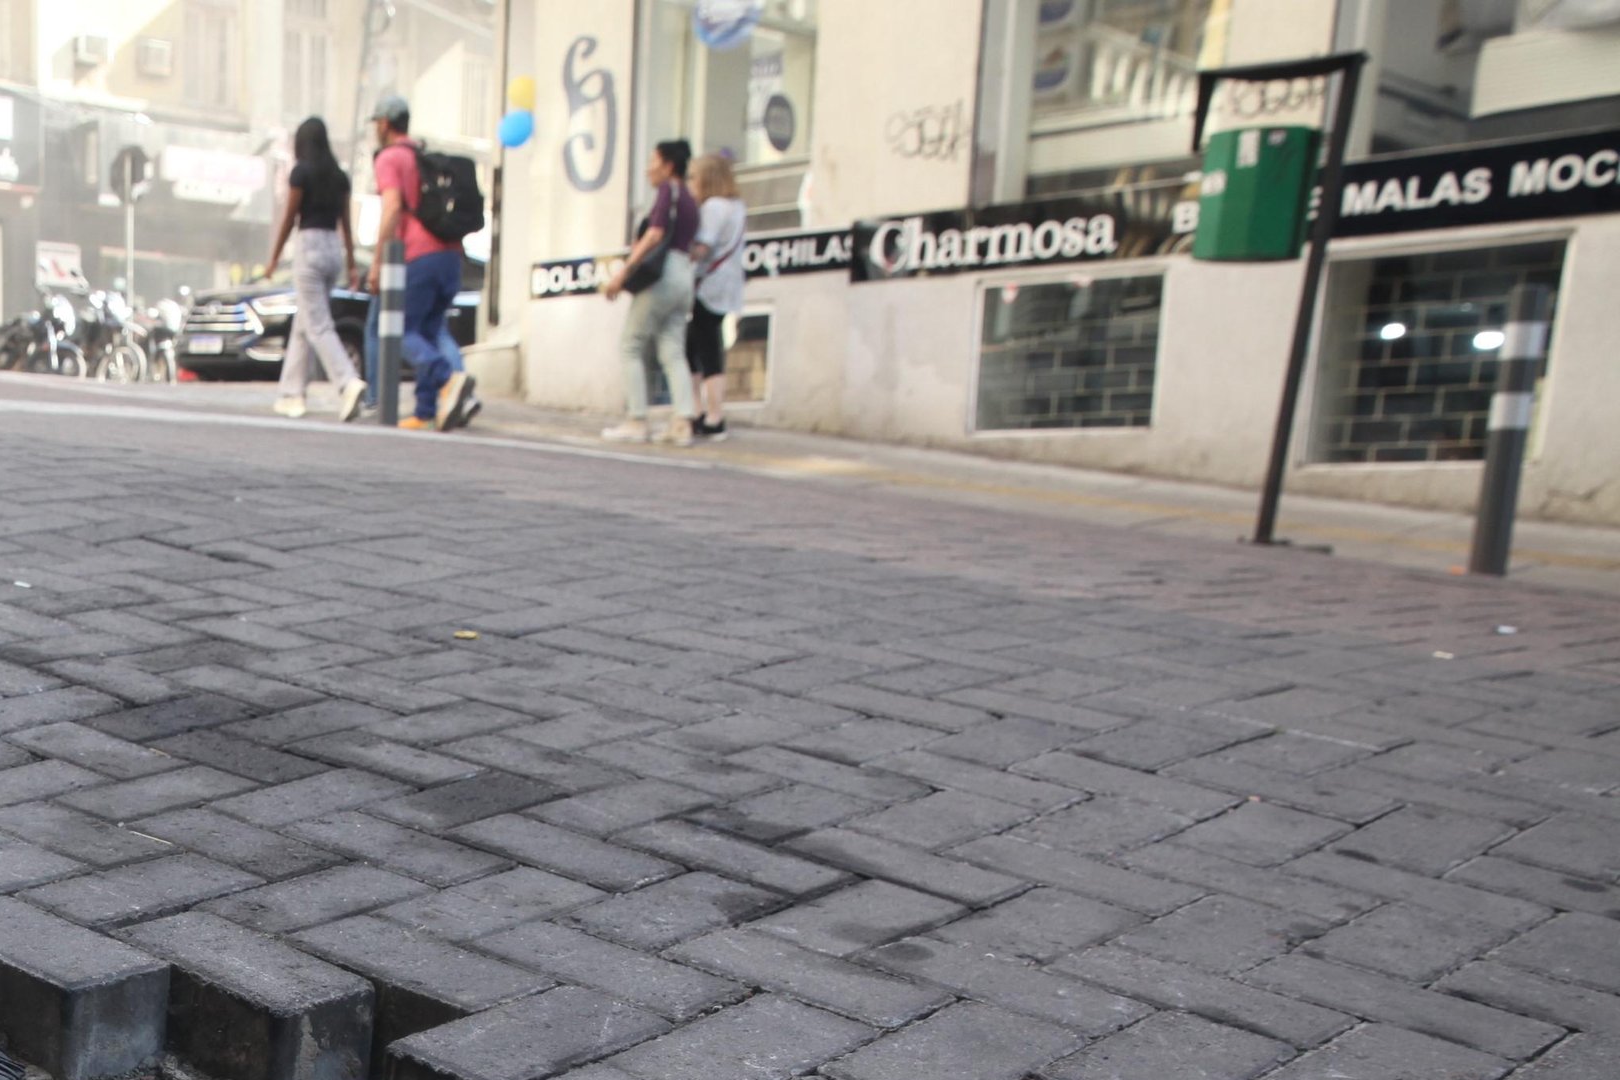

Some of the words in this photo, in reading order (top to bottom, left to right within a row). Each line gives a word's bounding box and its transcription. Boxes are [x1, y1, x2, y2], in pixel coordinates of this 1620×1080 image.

[1341, 167, 1492, 217] MALAS
[1508, 149, 1620, 197] MOC
[869, 213, 1118, 273] Charmosa
